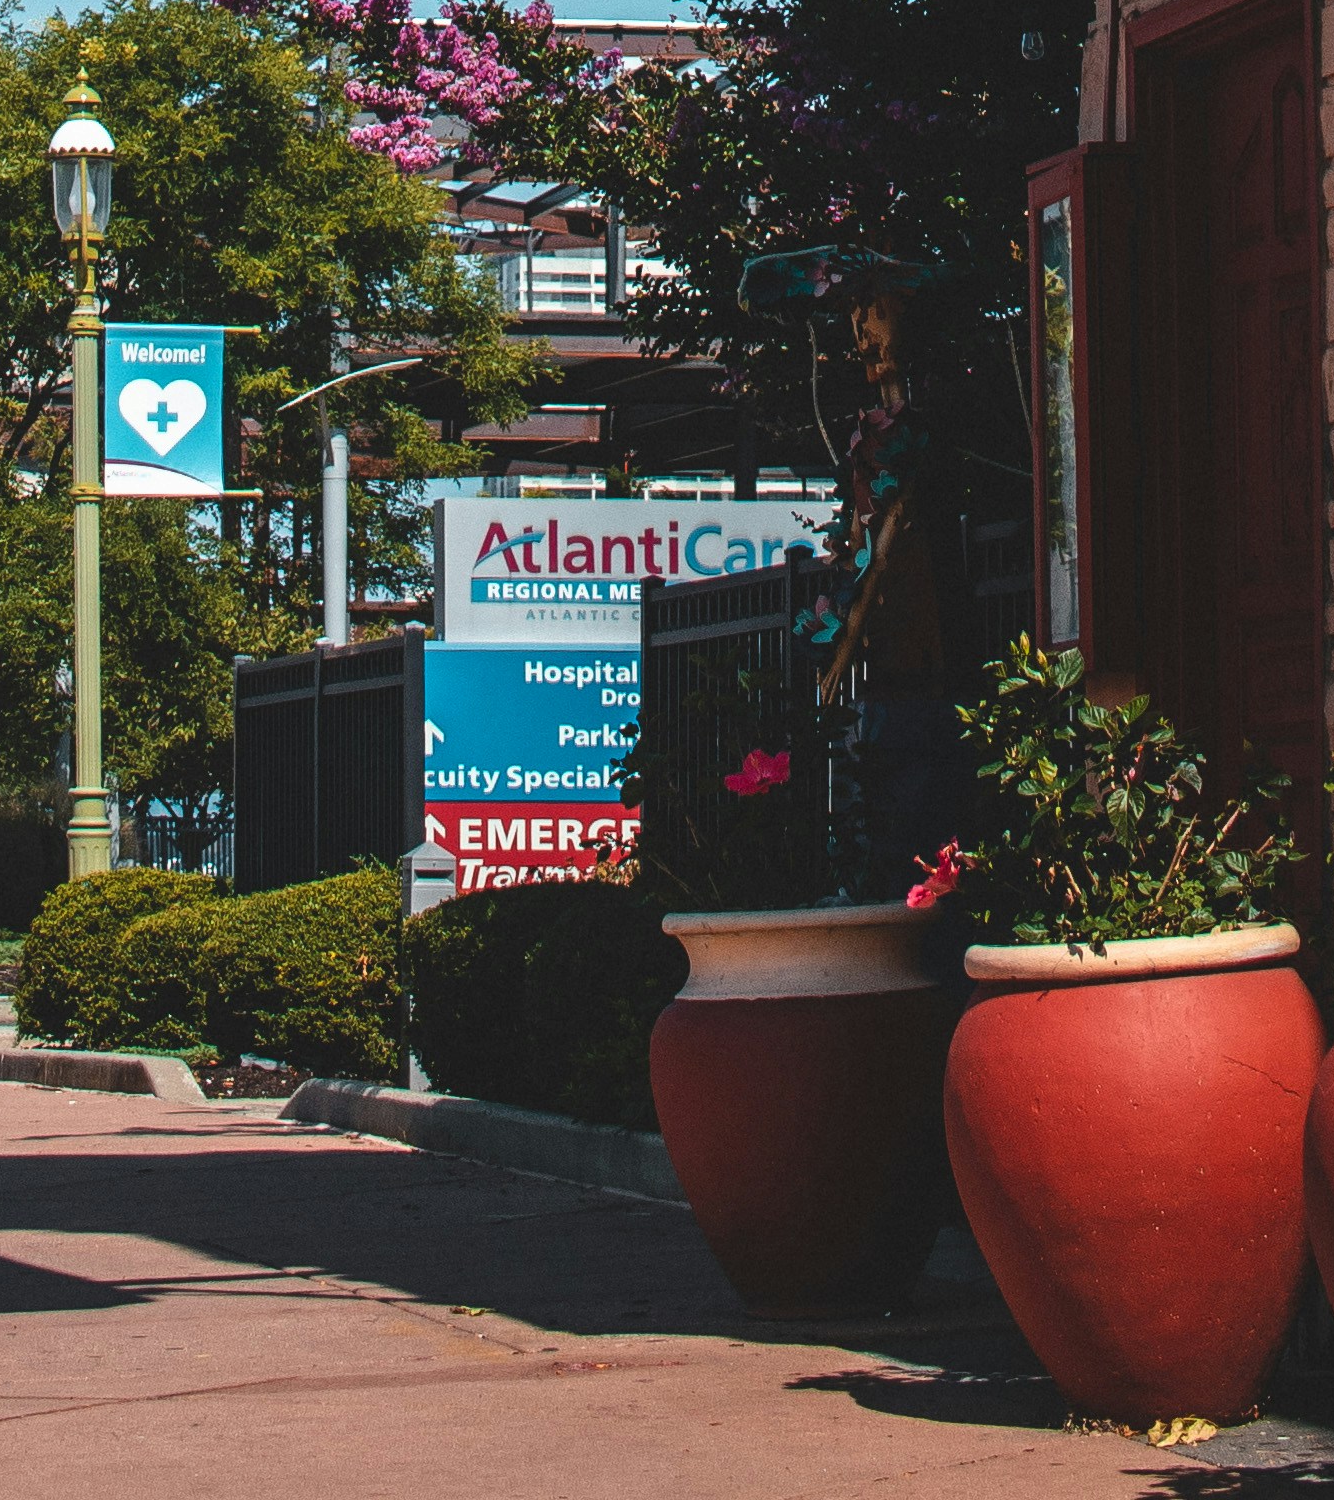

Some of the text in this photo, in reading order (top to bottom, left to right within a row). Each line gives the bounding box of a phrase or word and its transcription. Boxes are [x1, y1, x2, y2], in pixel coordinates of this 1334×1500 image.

[121, 342, 207, 364] Welcome!
[486, 582, 603, 601] REGIONAL
[525, 609, 621, 621] ATLANTIC
[523, 660, 639, 689] Hospital
